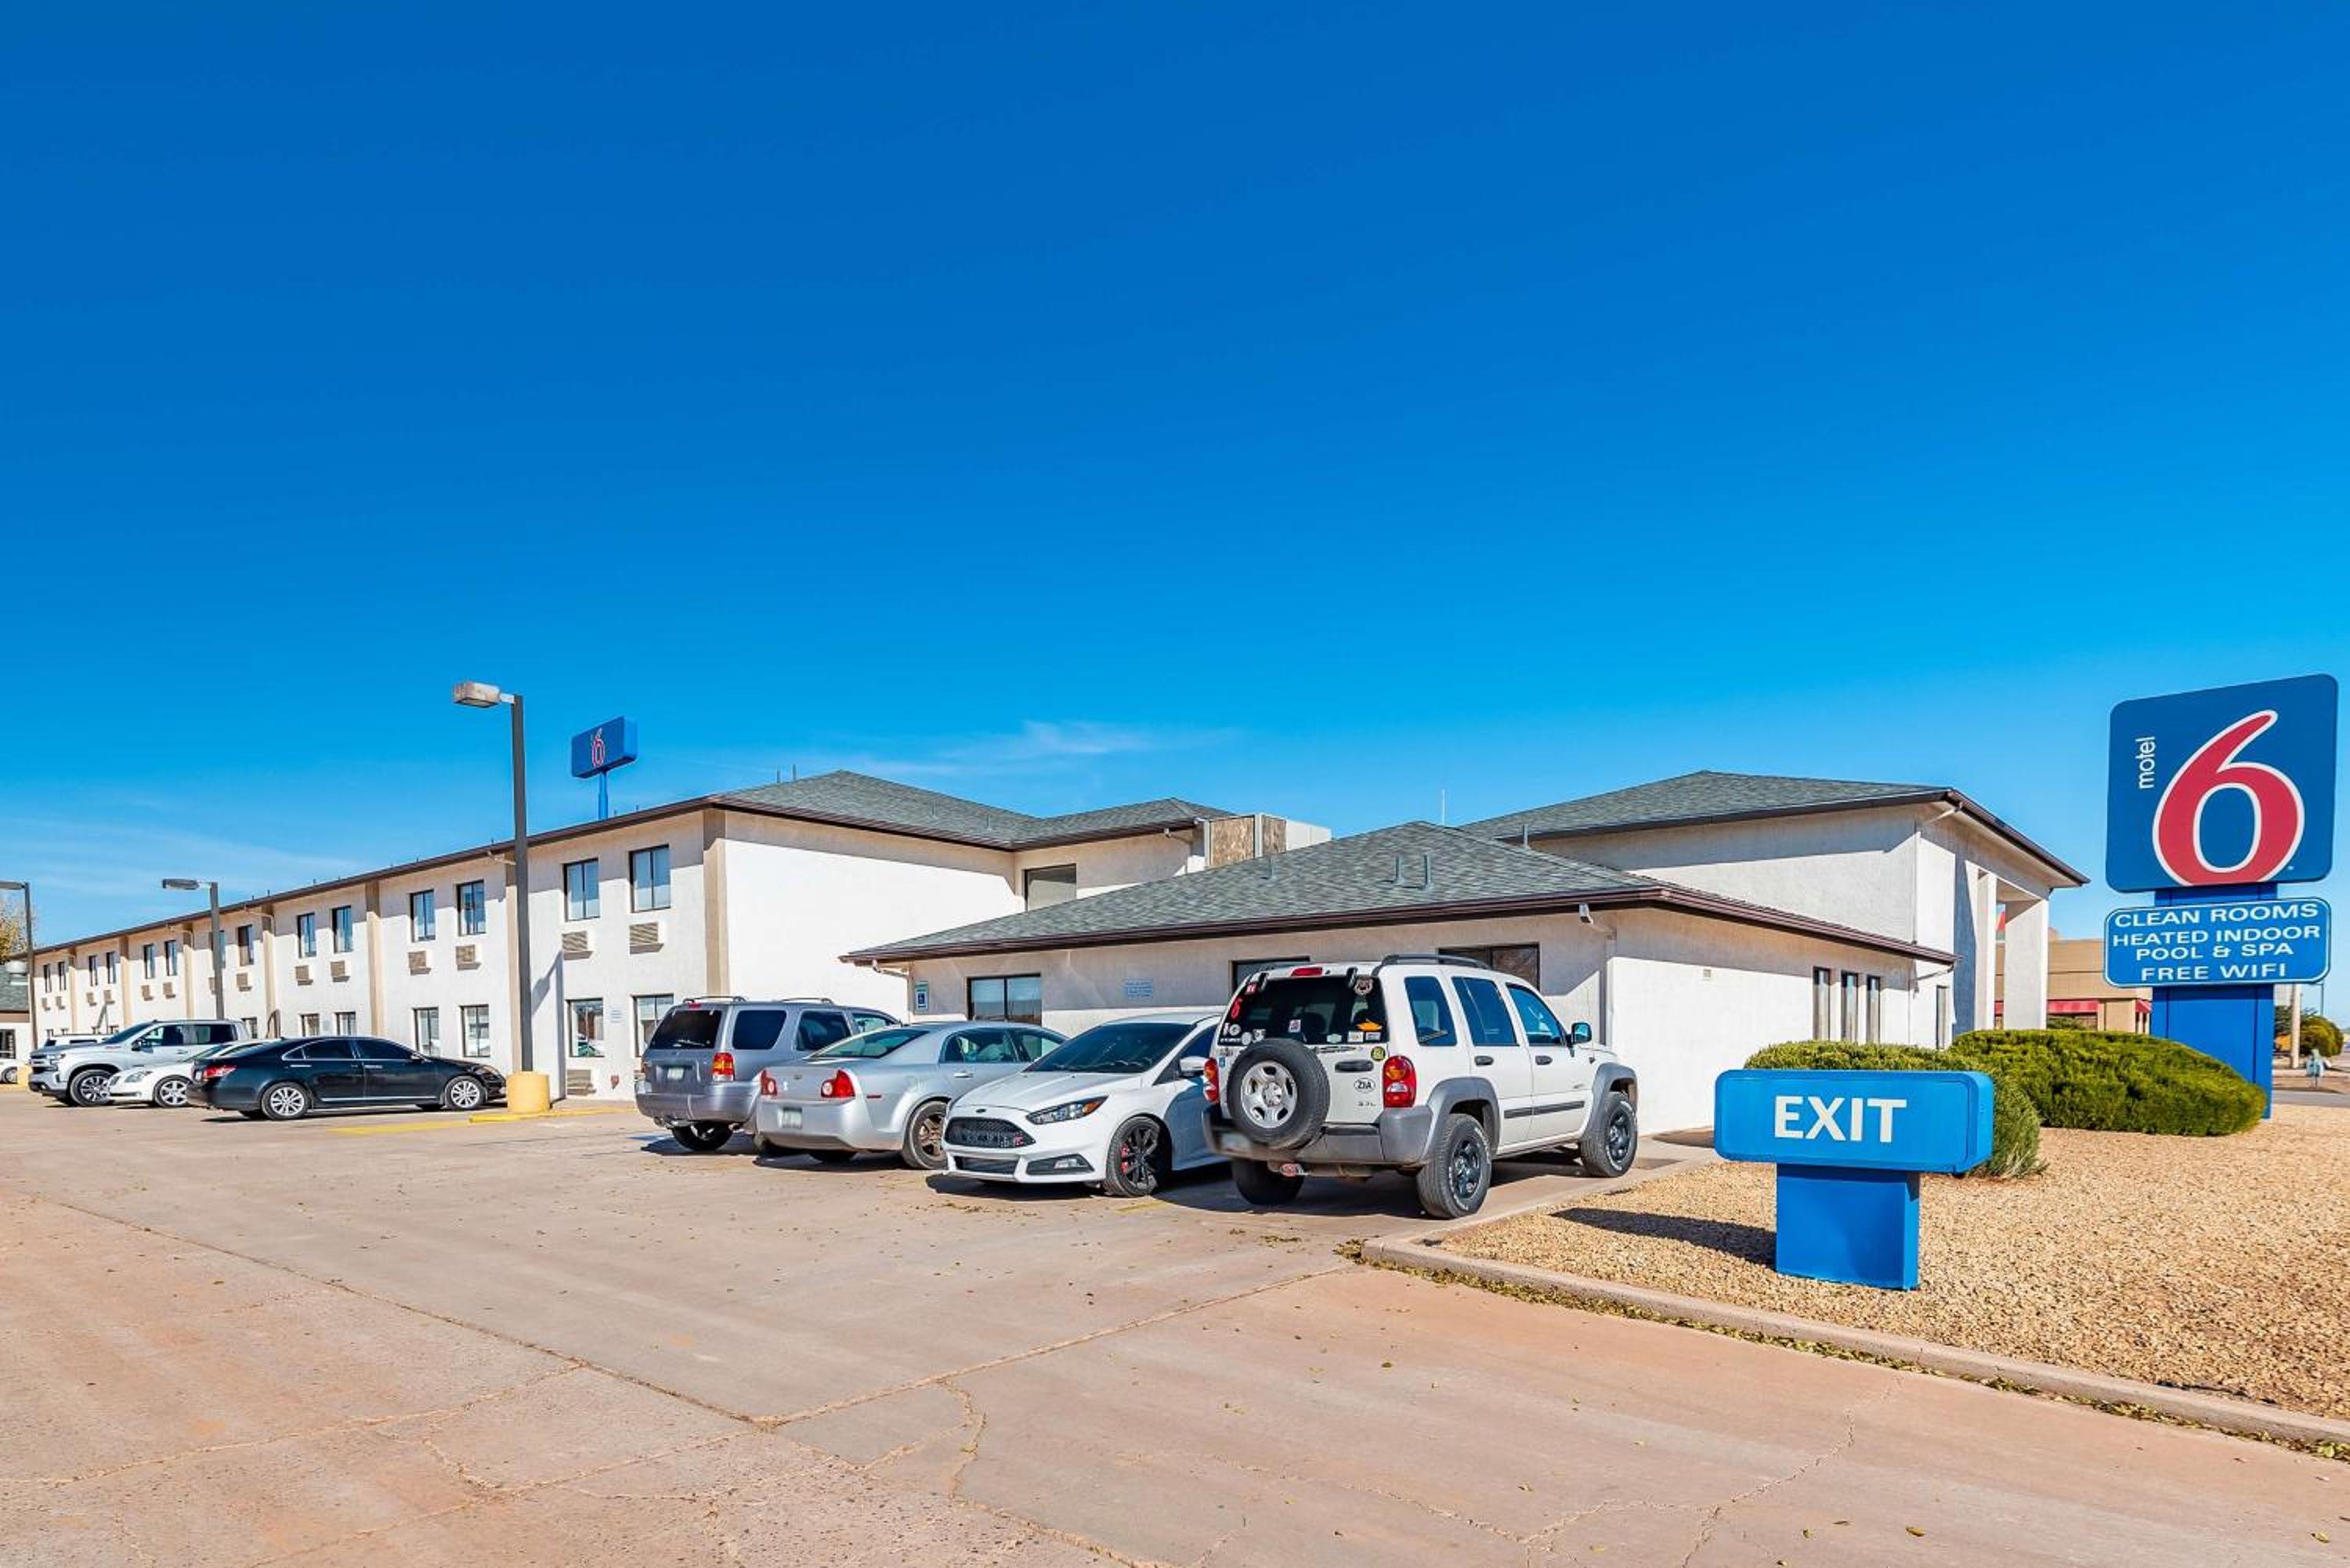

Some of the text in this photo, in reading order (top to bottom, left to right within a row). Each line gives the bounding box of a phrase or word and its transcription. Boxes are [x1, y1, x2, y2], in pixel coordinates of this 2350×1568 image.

[591, 727, 605, 768] 6
[2135, 709, 2305, 887] motel 6
[2115, 903, 2318, 927] CLEAN ROOMS
[2113, 925, 2320, 946] HEATED INDOOR
[2136, 942, 2294, 960] POOL & SPA
[2141, 963, 2286, 981] FREE WIFI
[1774, 1095, 1907, 1143] EXIT
